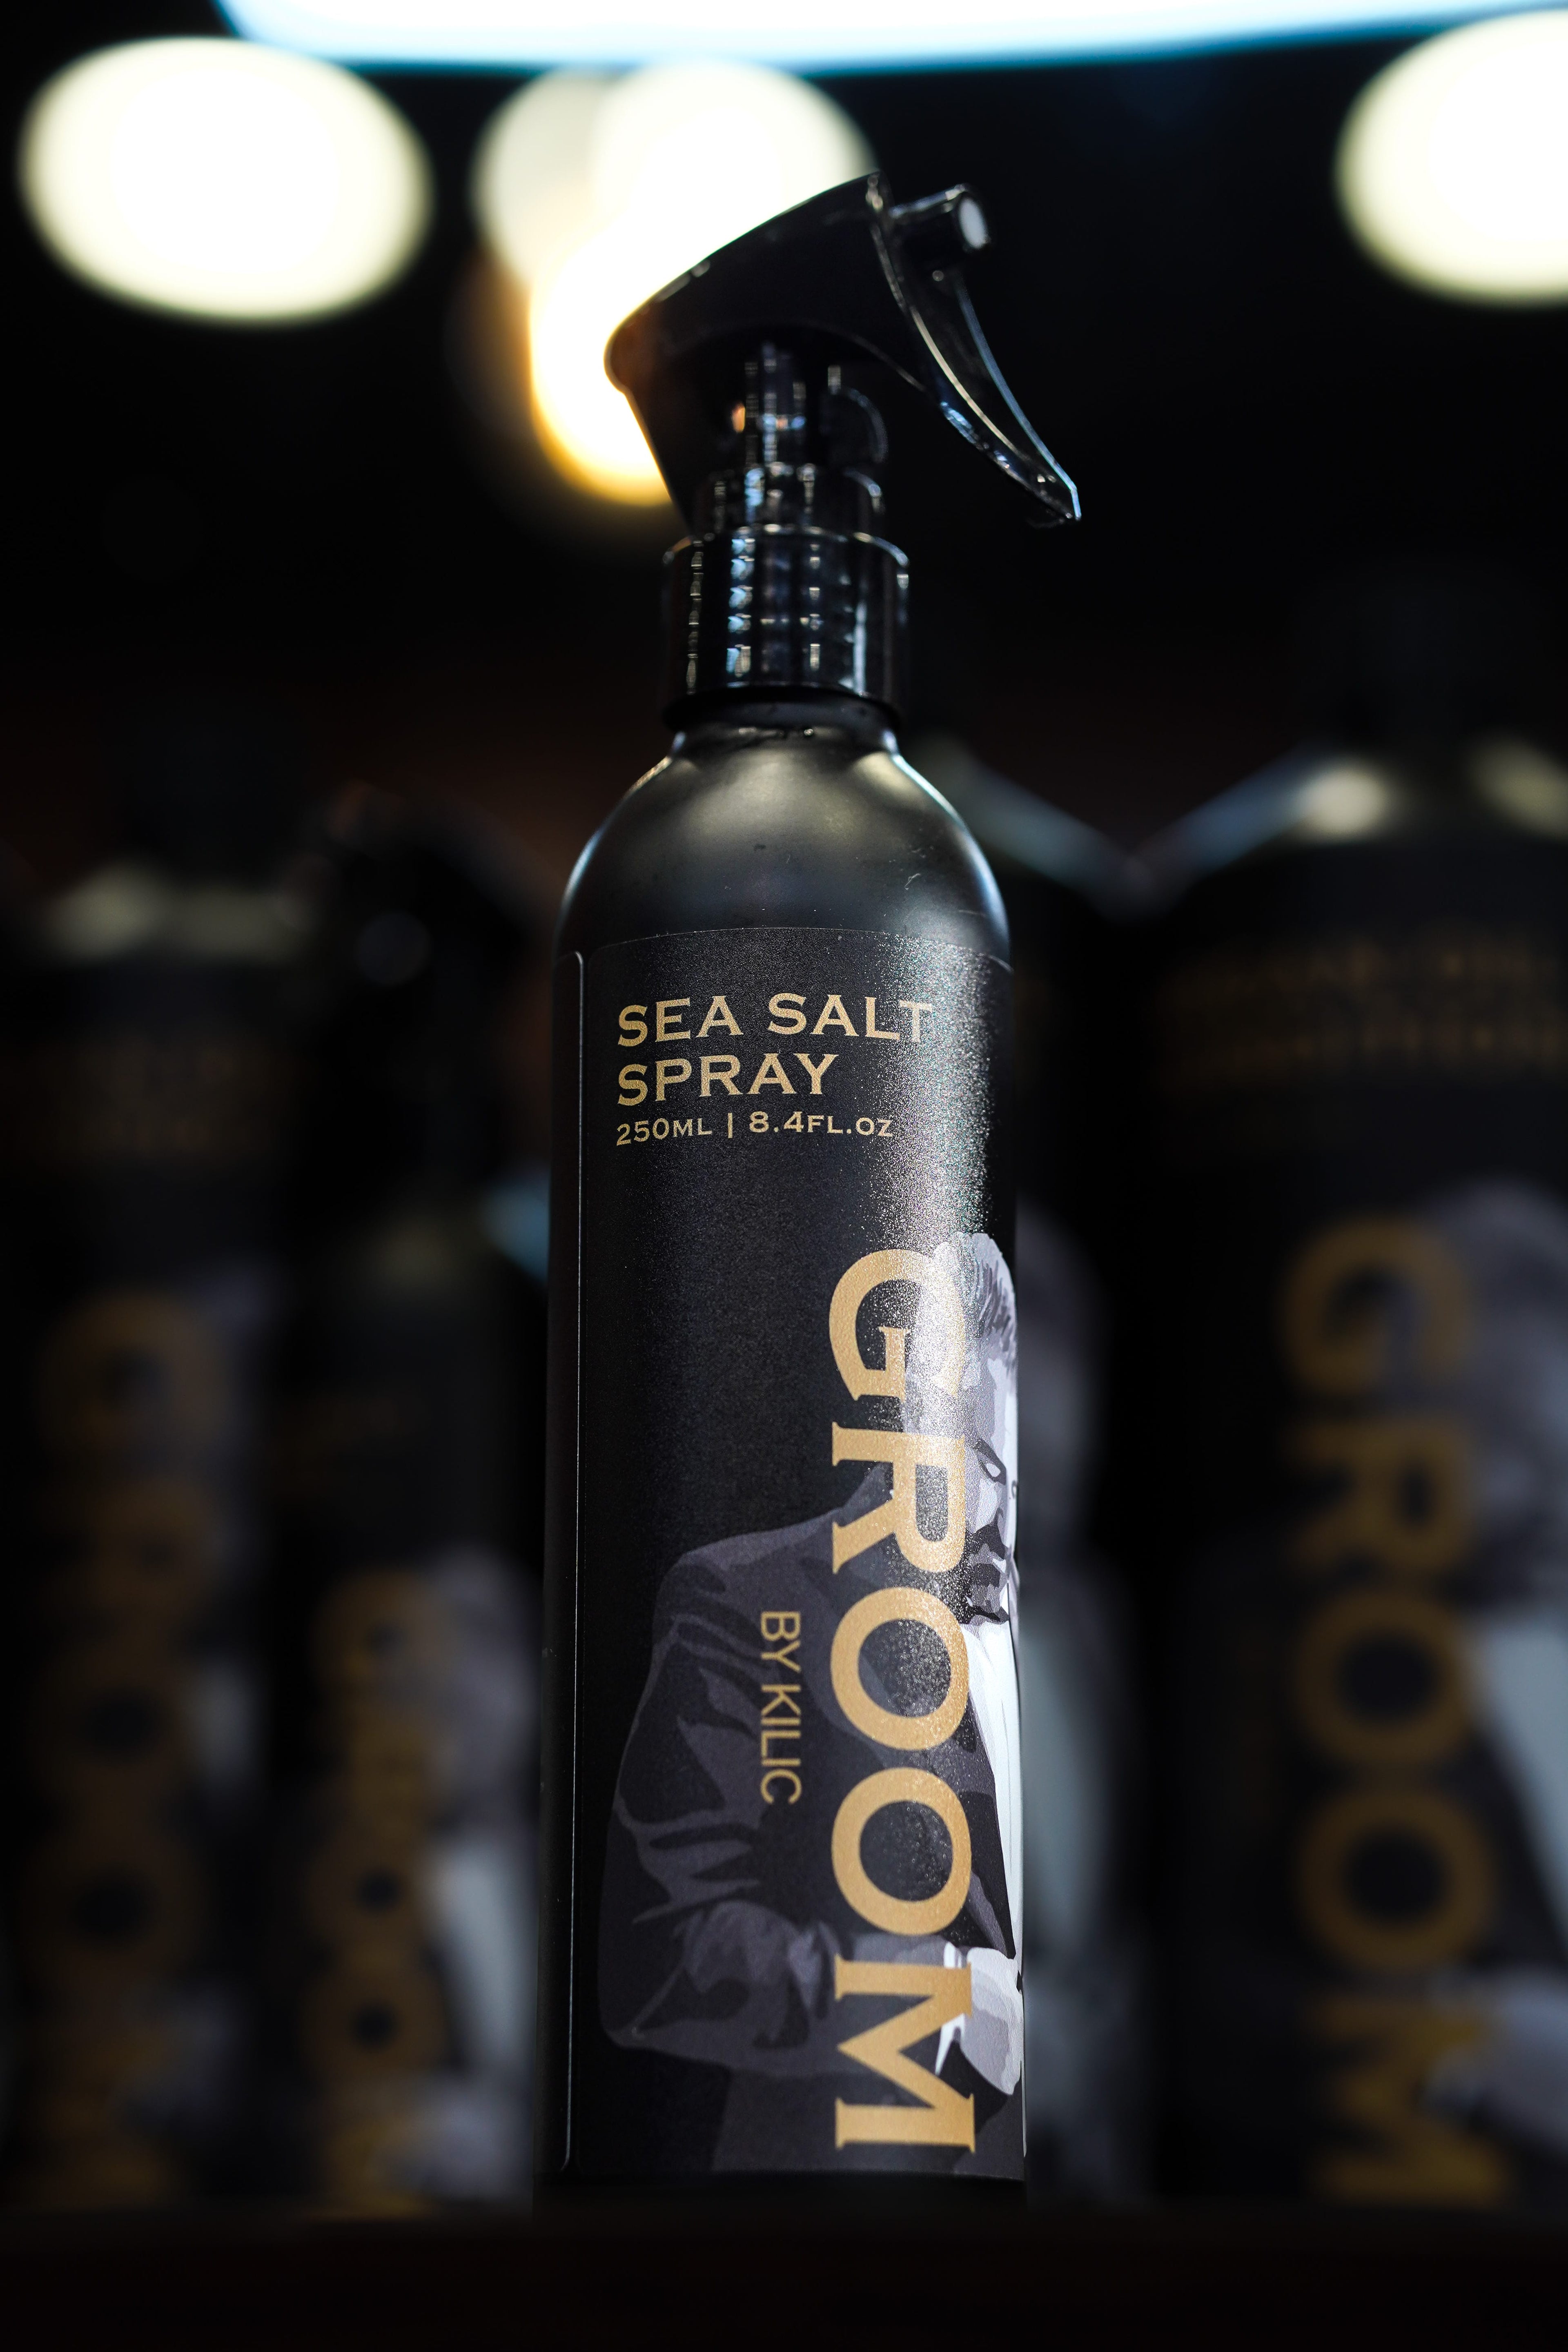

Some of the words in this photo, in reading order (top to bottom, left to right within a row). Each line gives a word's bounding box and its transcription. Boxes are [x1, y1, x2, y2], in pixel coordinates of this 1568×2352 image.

[617, 995, 744, 1047] SEA
[768, 992, 933, 1043] SALT
[617, 1052, 840, 1106] SPRAY
[616, 1116, 713, 1146] 250ML
[748, 1110, 893, 1138] 8.4FL.OZ
[760, 1611, 802, 1673] BY
[829, 1248, 976, 2153] GROOM
[760, 1684, 802, 1804] KILIC
